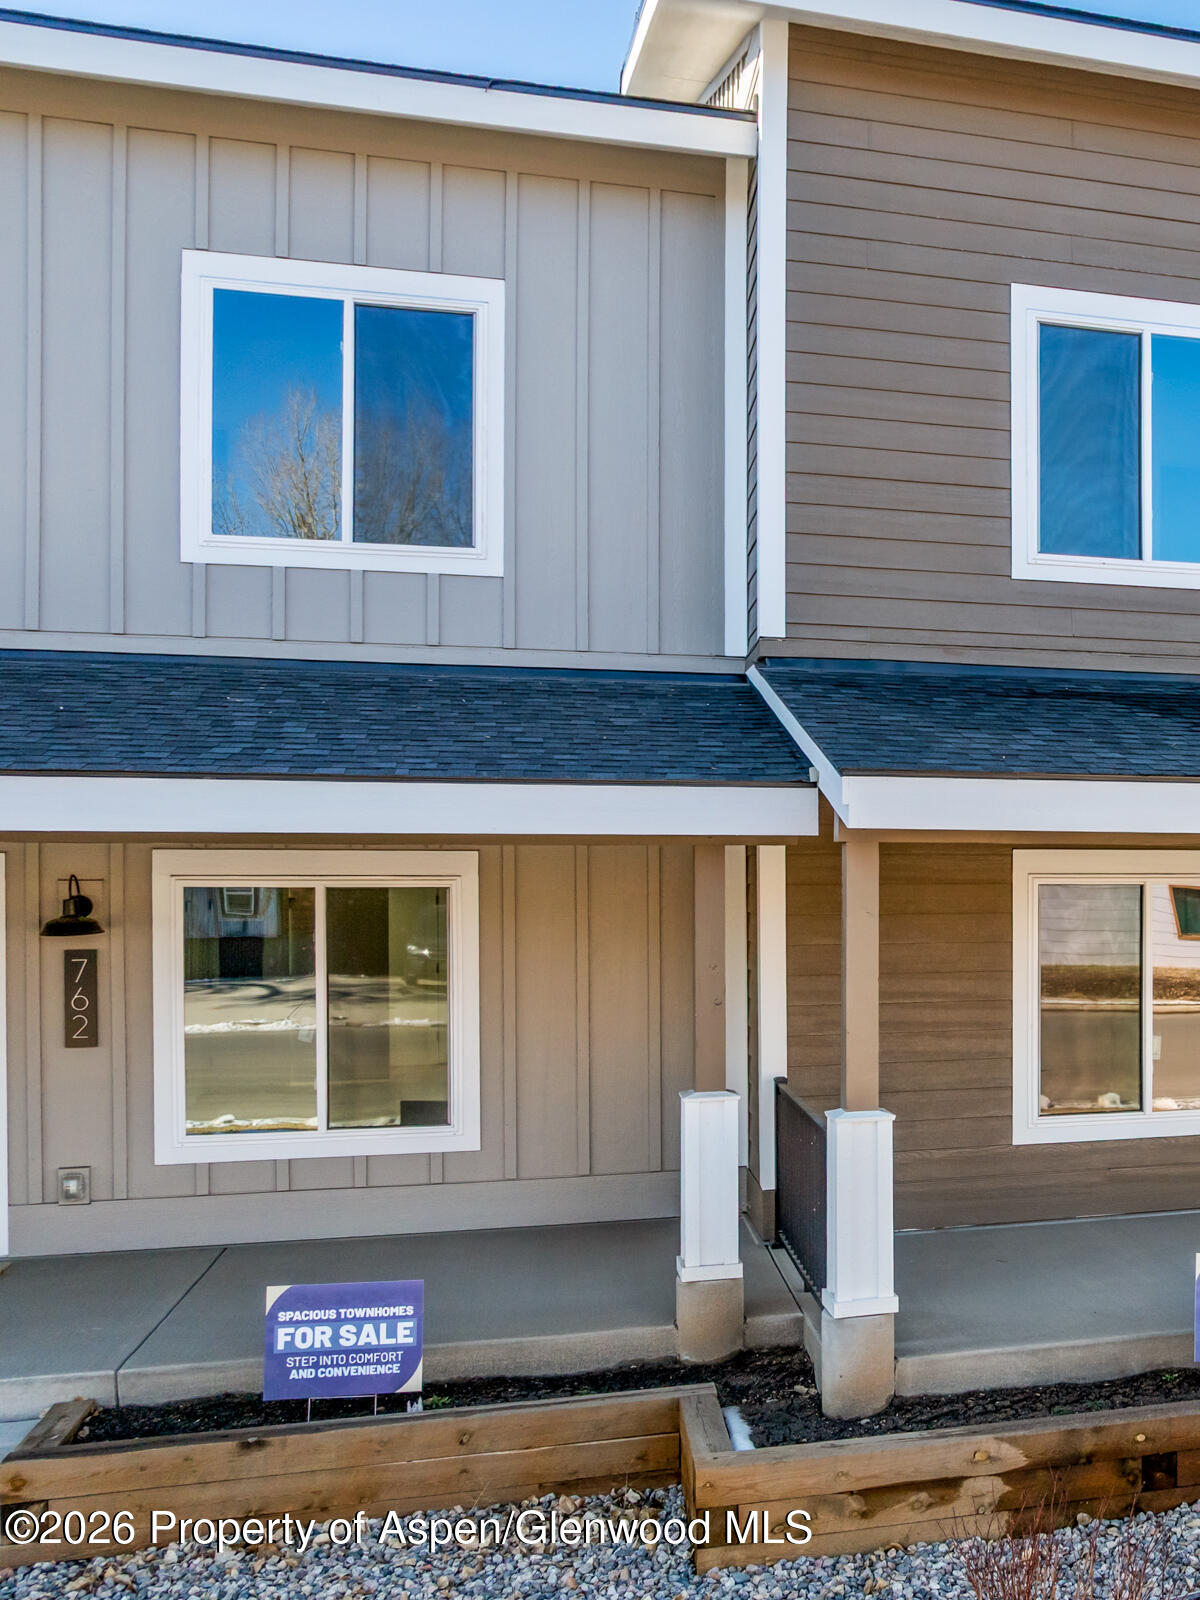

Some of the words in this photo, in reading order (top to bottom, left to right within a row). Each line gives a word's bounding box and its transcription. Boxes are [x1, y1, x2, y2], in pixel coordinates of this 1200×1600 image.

[71, 959, 89, 1039] 762
[277, 1309, 337, 1322] SPACIOUS
[339, 1306, 414, 1319] TOWNHOMES
[277, 1325, 332, 1350] FOR
[339, 1321, 414, 1347] SALE
[286, 1356, 317, 1368] STEP
[319, 1354, 346, 1366] INTO
[348, 1351, 404, 1364] COMFORT
[289, 1368, 316, 1380] AND
[317, 1363, 400, 1378] CONVENIENCE
